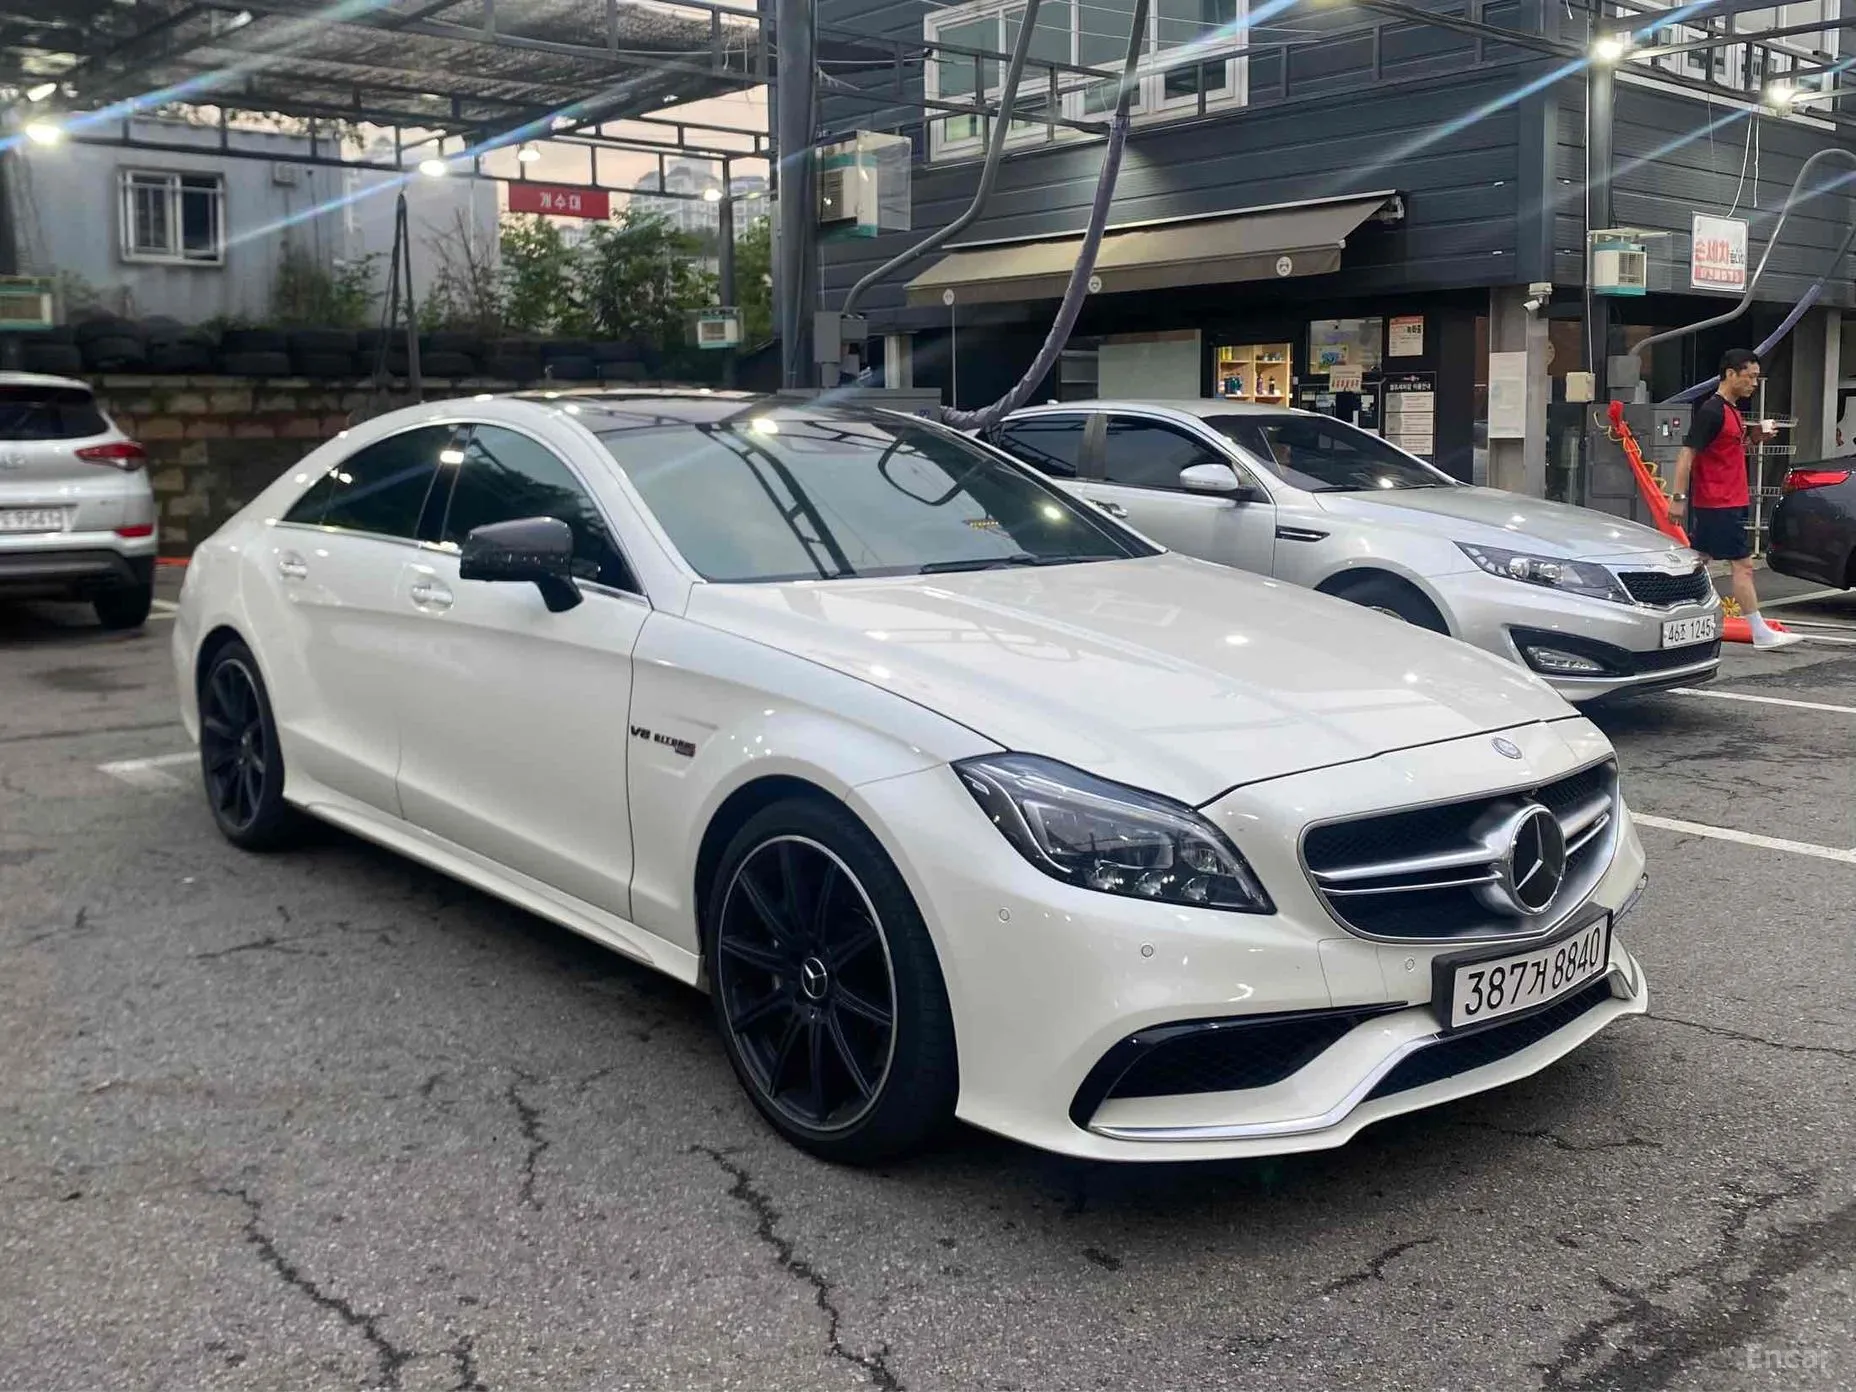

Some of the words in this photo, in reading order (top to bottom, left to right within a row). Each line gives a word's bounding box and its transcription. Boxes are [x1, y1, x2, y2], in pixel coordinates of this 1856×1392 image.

[540, 191, 581, 211] 개수대
[1668, 624, 1686, 642] 46조
[1691, 618, 1711, 639] 1245
[631, 725, 650, 740] V8
[1465, 958, 1548, 1015] 387거
[1552, 927, 1600, 990] 8840
